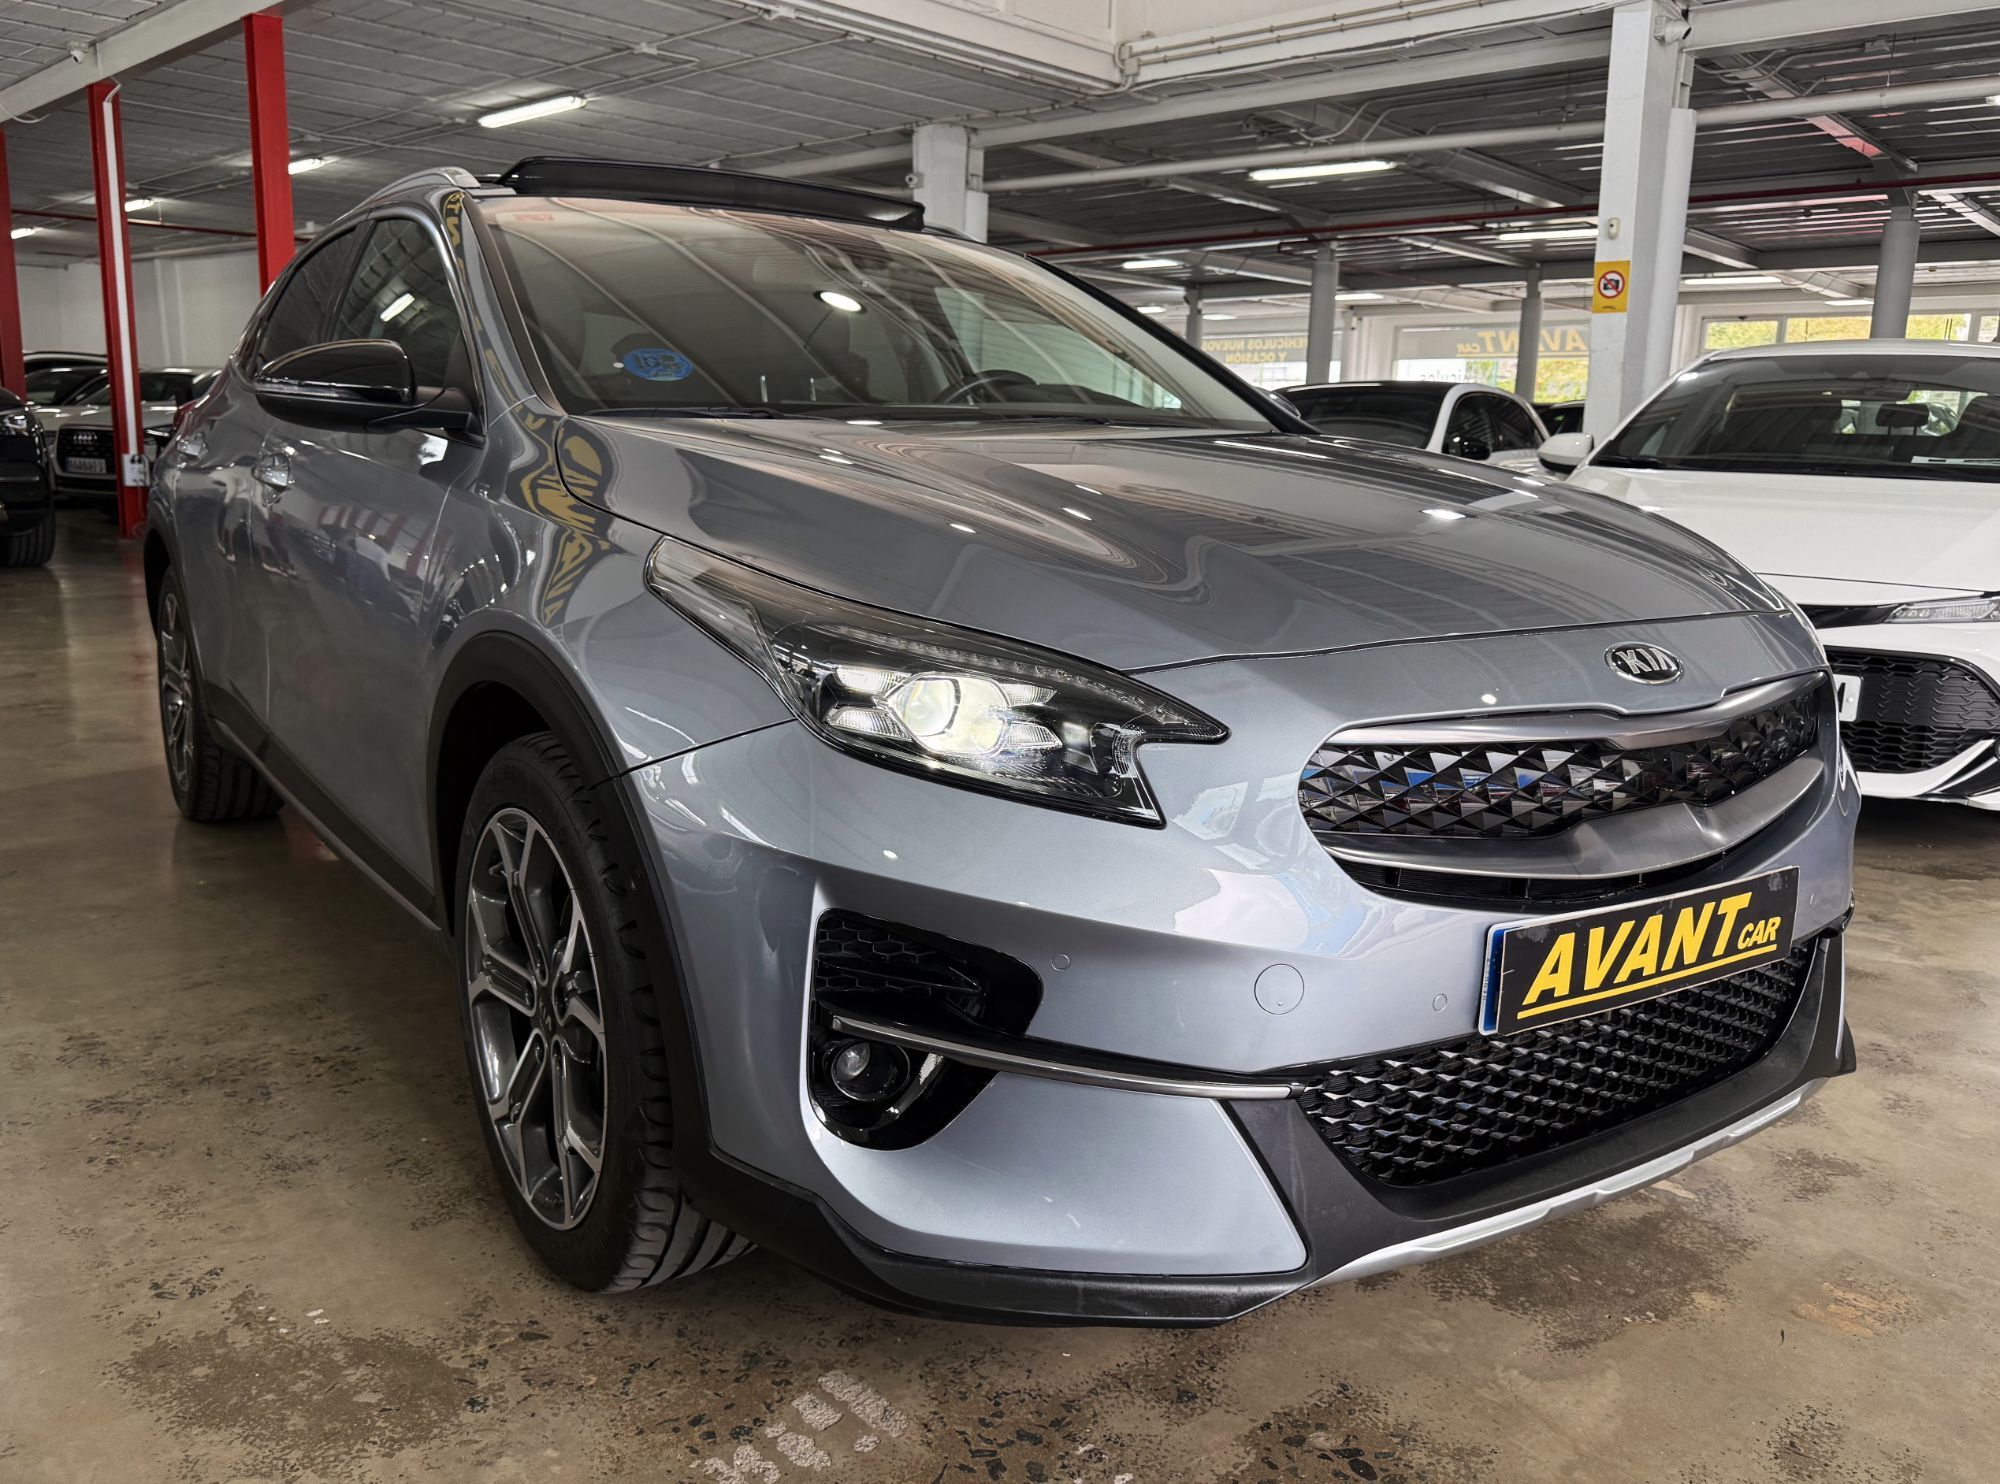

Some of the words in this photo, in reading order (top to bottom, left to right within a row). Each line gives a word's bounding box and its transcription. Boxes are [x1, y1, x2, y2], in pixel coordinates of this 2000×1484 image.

[1615, 648, 1678, 674] KIA
[1522, 891, 1752, 1006] AVANT
[1737, 916, 1781, 950] CAR
